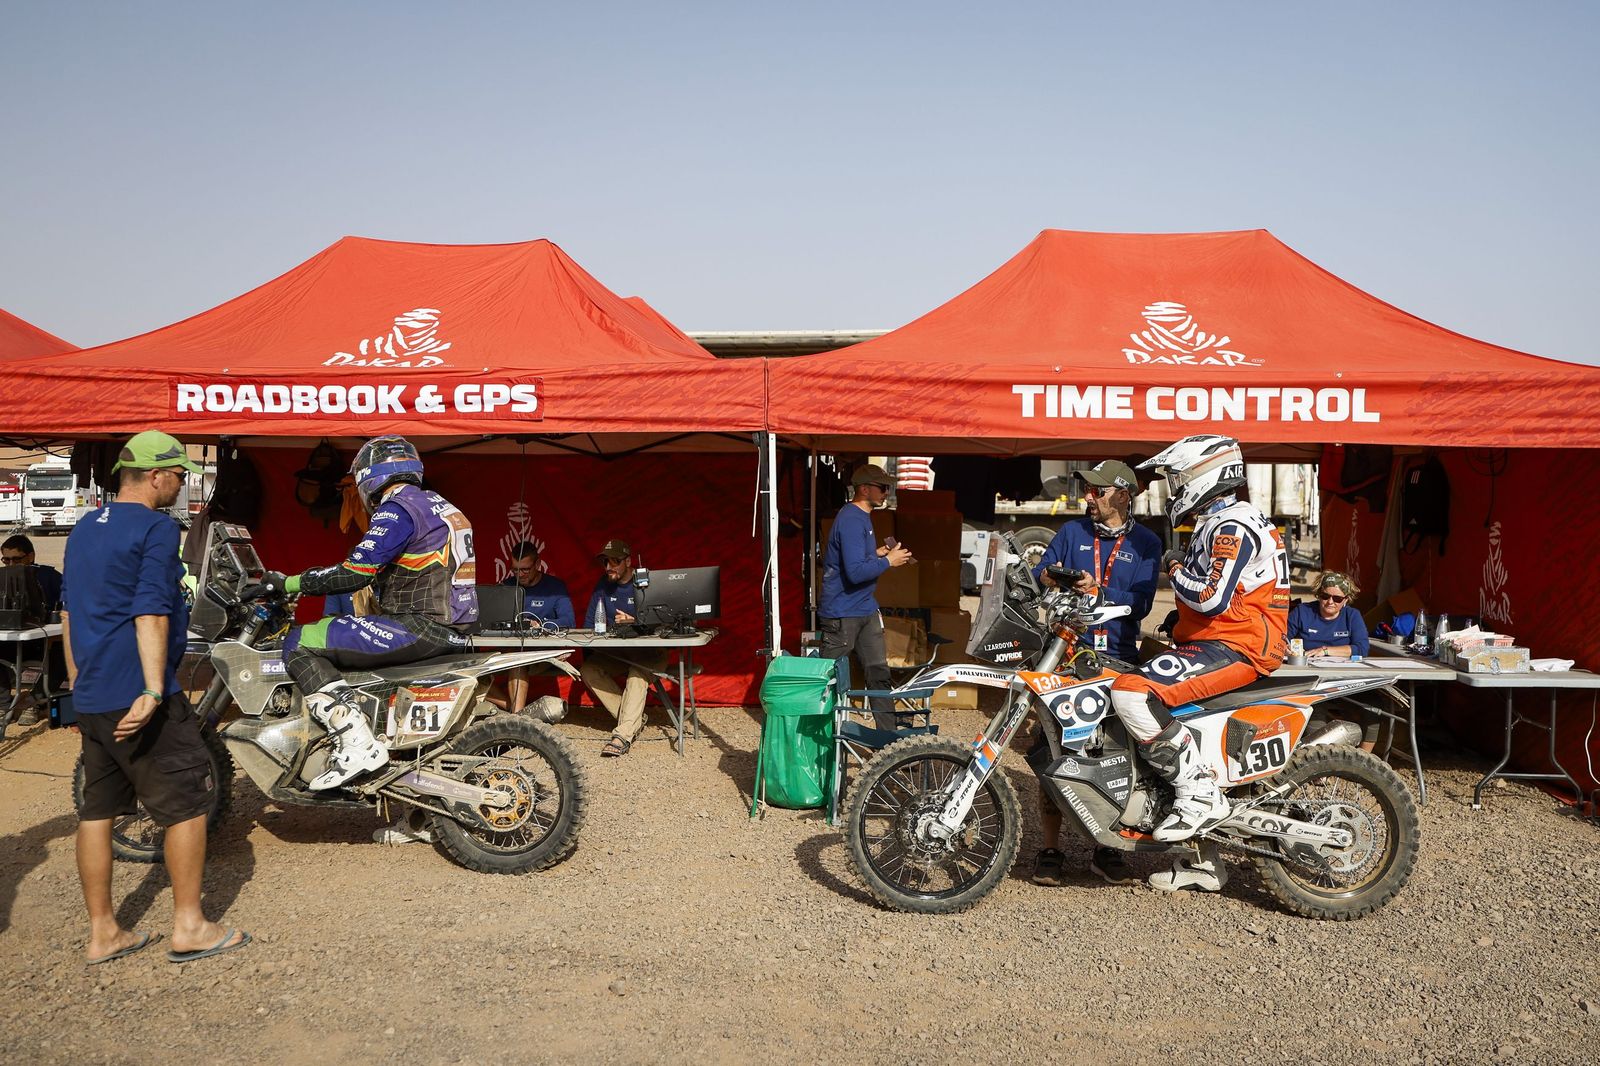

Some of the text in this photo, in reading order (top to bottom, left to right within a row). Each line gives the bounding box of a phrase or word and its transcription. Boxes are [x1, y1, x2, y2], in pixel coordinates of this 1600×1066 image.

[1121, 348, 1262, 367] DAKAR
[177, 384, 538, 414] ROADBOOK & GPS
[1012, 385, 1381, 423] TIME CONTROL
[1214, 536, 1239, 548] COX
[1479, 587, 1513, 625] DAKAR
[994, 652, 1022, 662] JOYRIDE
[411, 705, 441, 731] 81
[1100, 756, 1127, 768] MESTA
[1061, 785, 1103, 836] FJALLVENTURE
